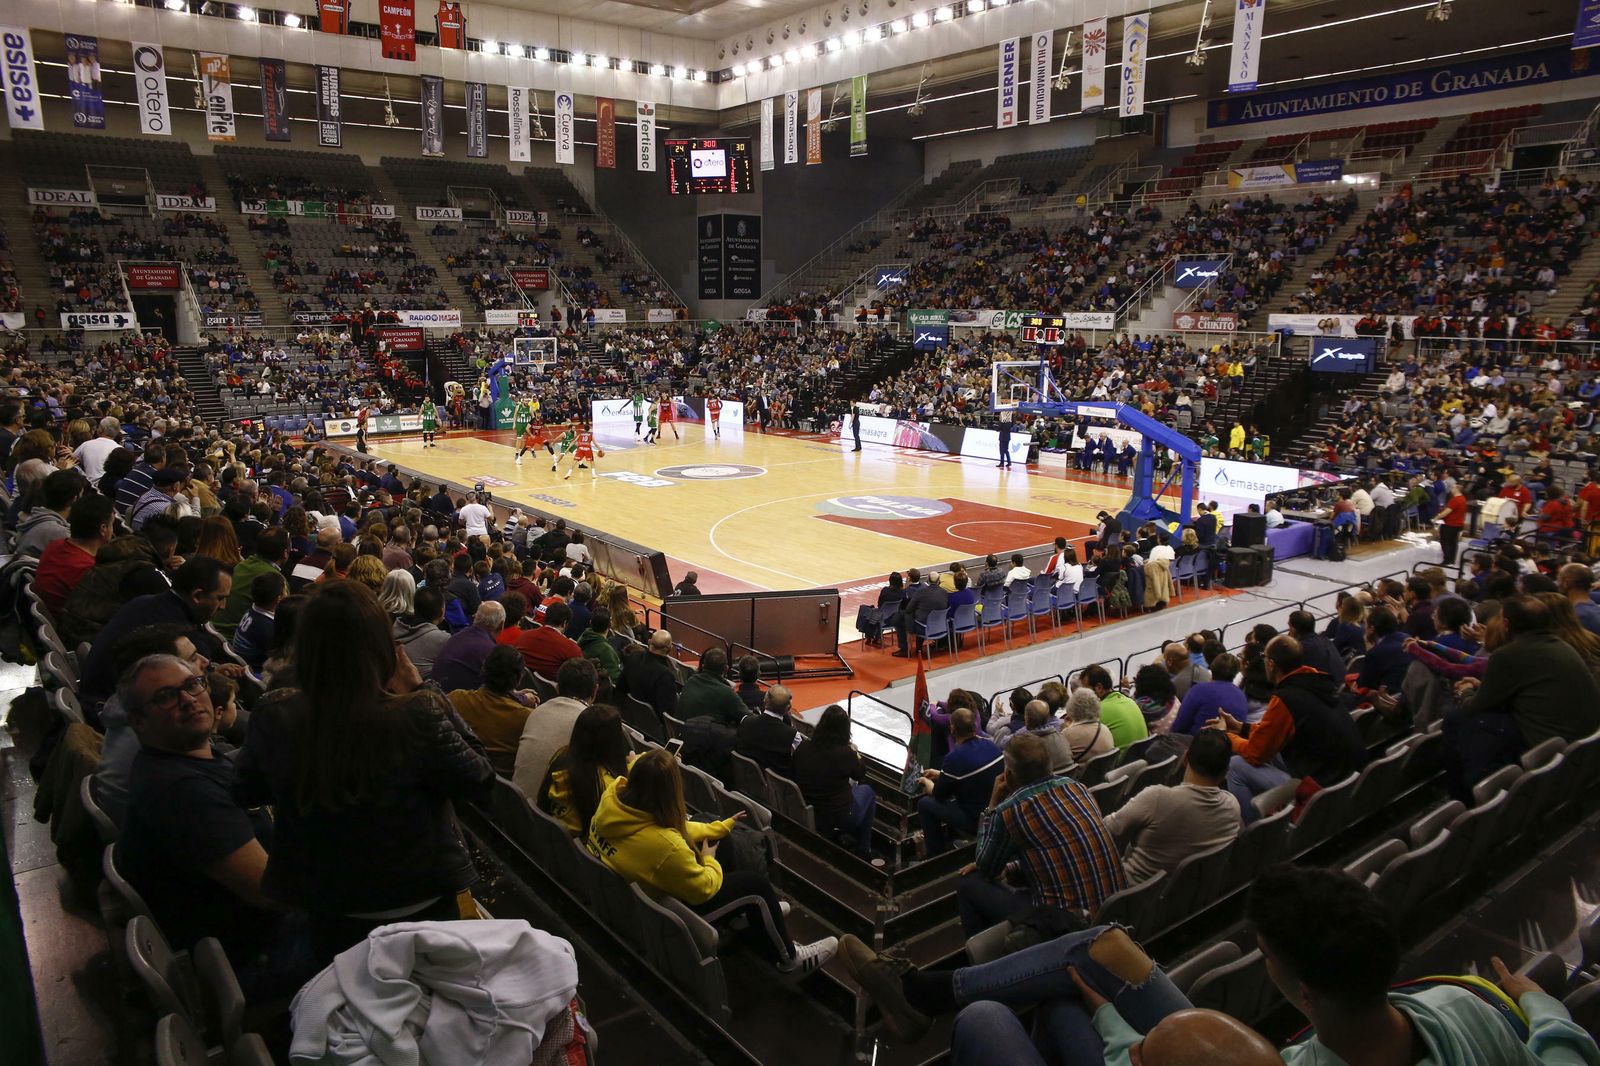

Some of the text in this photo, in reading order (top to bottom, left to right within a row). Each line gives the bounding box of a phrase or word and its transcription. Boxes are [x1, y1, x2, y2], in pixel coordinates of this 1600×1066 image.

[383, 5, 412, 17] CAMPEÓN
[1240, 11, 1254, 80] MANZANO
[4, 32, 33, 104] asisa
[1002, 40, 1015, 108] BERNER
[144, 77, 164, 132] otero
[322, 76, 330, 105] VERDAD
[329, 67, 340, 117] BURGERS
[1240, 62, 1550, 120] AYUNTAMIENTO DE GRANADA
[209, 95, 234, 133] enPie
[512, 88, 523, 146] Rossellimac
[561, 113, 572, 150] Cuerva
[641, 119, 651, 169] fertisac
[787, 109, 795, 161] emasagra
[735, 143, 745, 151] 30
[32, 190, 92, 203] IDEAL
[161, 196, 212, 209] IDEAL
[420, 208, 460, 218] IDEAL
[509, 212, 547, 222] IDEAL
[131, 267, 176, 275] AYUNTAMIENTO
[67, 314, 110, 325] asisa
[1197, 320, 1235, 331] CHIKITO
[860, 428, 888, 438] masagra
[1229, 479, 1285, 493] emasagra
